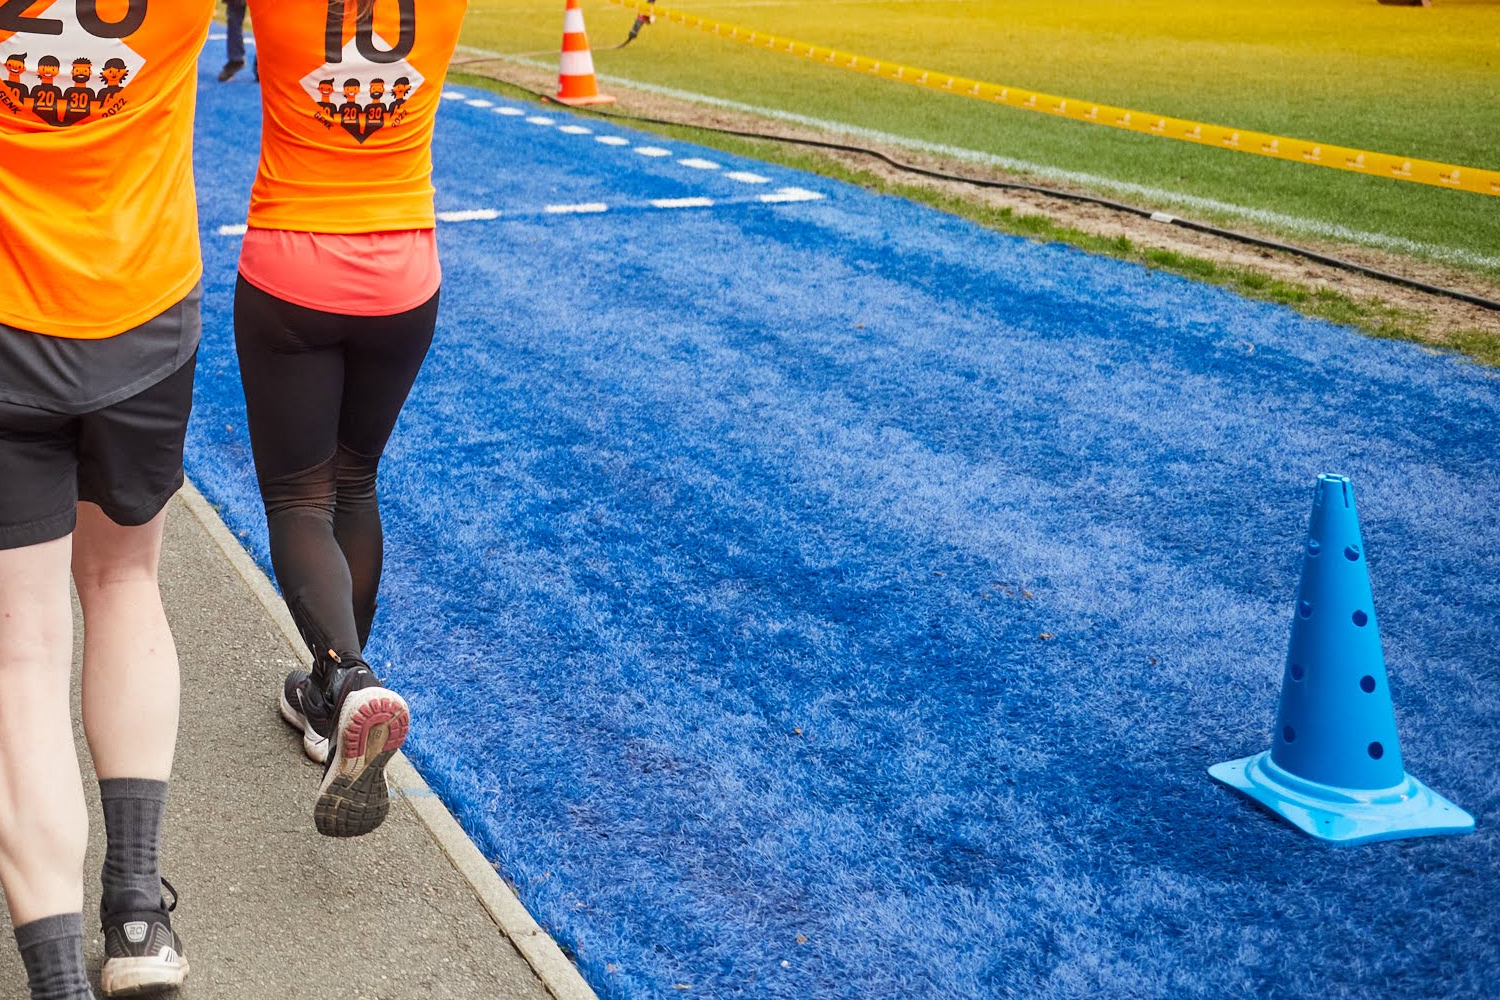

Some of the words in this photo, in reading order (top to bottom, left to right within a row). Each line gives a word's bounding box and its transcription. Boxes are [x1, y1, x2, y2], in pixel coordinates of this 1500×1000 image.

[37, 89, 55, 107] 20
[70, 91, 88, 108] 30
[343, 107, 357, 120] 20
[368, 106, 382, 119] 30
